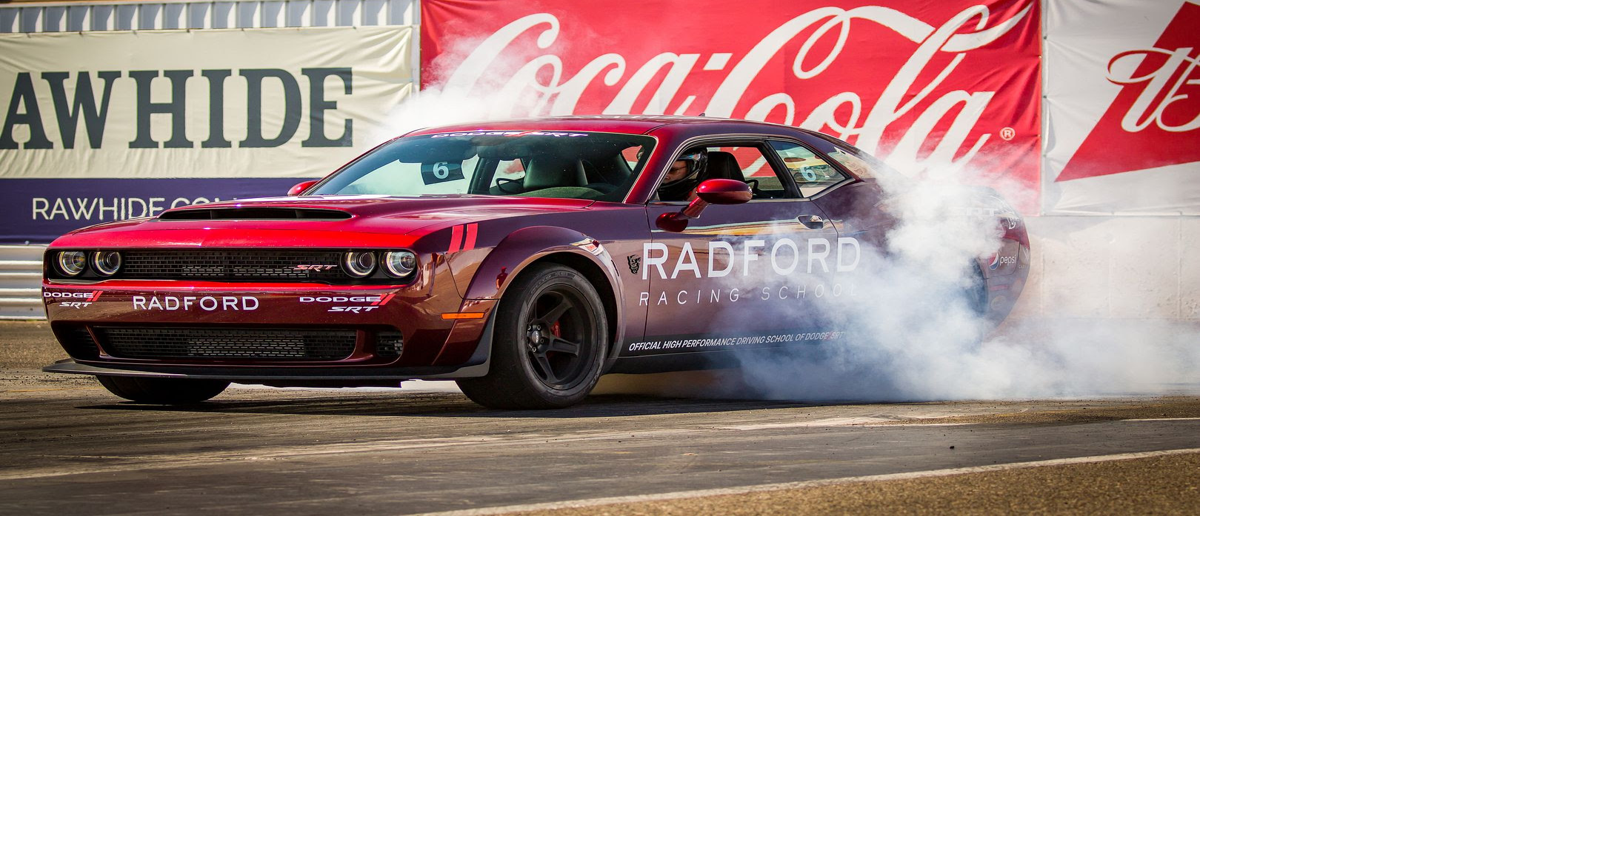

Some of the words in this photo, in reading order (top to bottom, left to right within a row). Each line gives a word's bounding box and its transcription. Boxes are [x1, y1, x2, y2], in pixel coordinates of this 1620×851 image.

[440, 2, 1034, 172] Coca-Cola
[0, 67, 353, 149] AWHIDE
[432, 161, 450, 179] 6
[800, 164, 817, 182] 6
[32, 197, 237, 220] RAWHIDEC
[641, 236, 861, 280] RADFORD
[1000, 254, 1016, 266] pepsi
[293, 264, 338, 272] SRT
[132, 295, 260, 311] RADFORD
[638, 287, 740, 306] RACING
[761, 283, 858, 301] SCHOOL
[59, 301, 93, 309] SRT
[327, 306, 379, 314] SRT
[628, 341, 661, 351] OFFICIAL
[662, 339, 681, 349] HIGH
[682, 337, 736, 348] PERFORMANCE
[736, 335, 766, 346] DRIVING
[765, 333, 794, 343] SCHOOL
[795, 332, 806, 341] OF
[805, 331, 829, 341] DODGE
